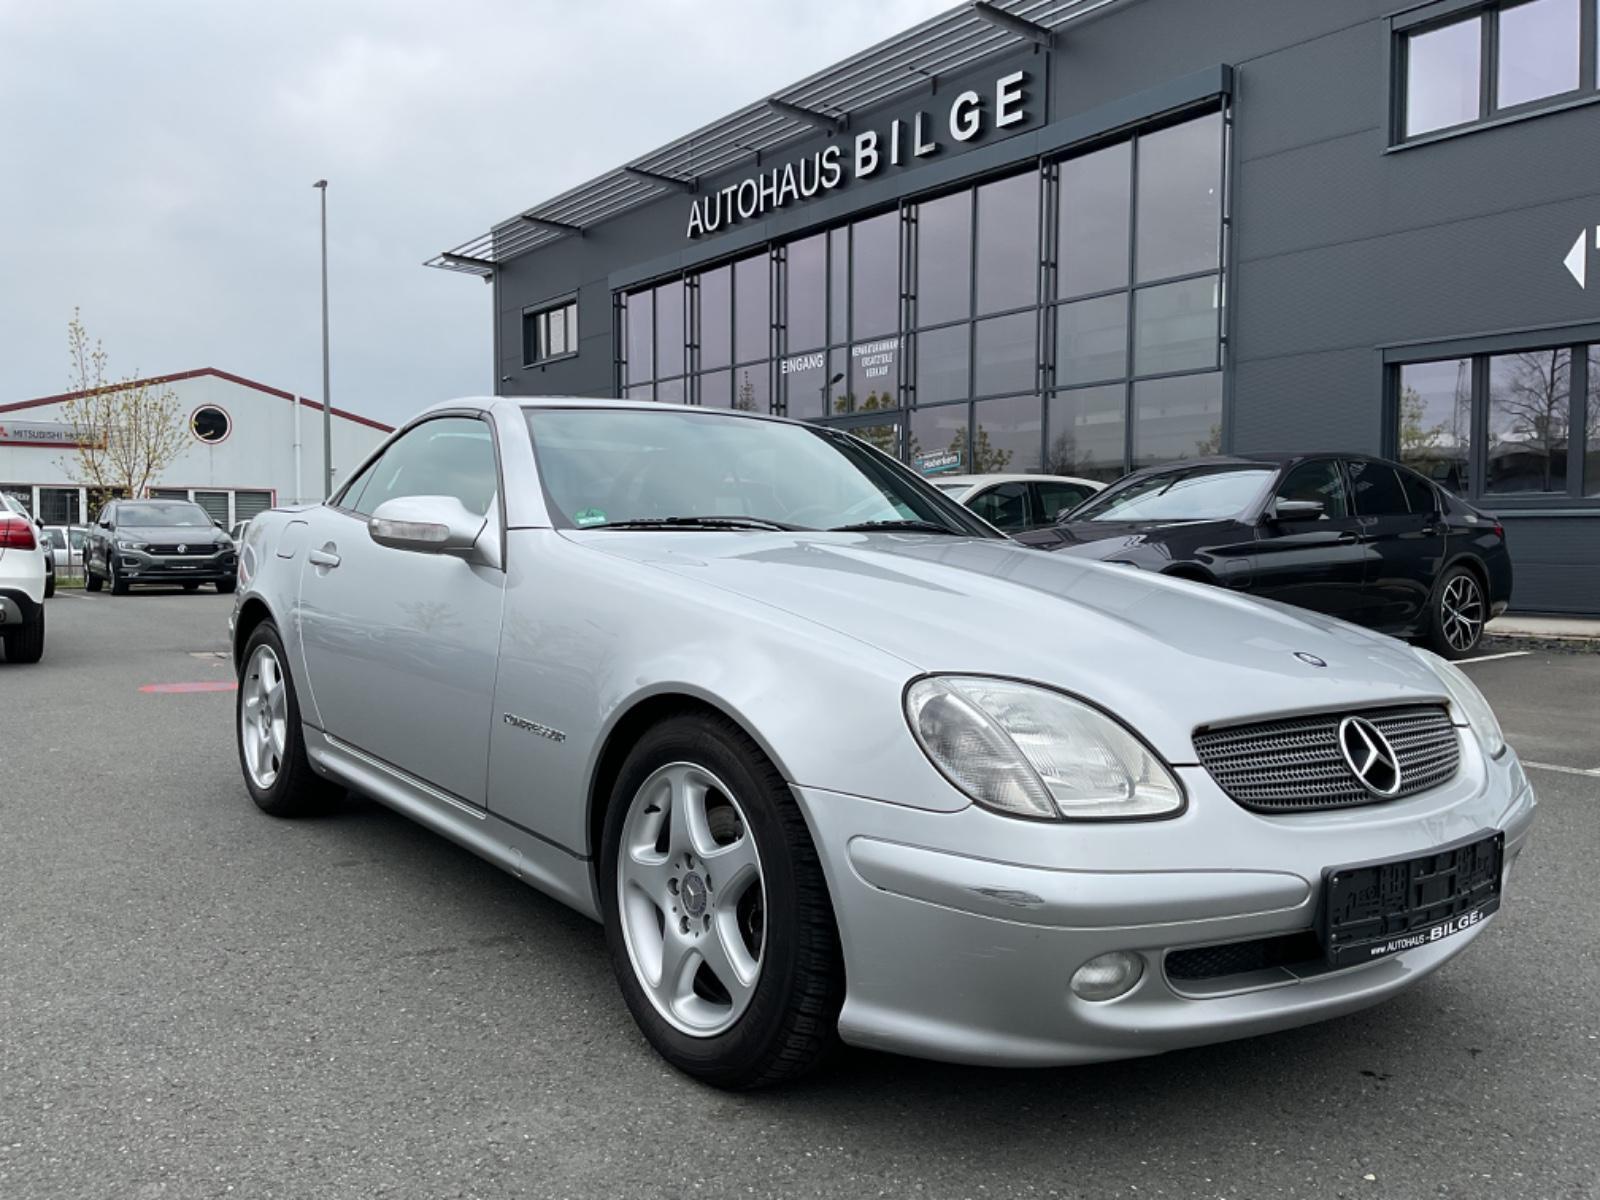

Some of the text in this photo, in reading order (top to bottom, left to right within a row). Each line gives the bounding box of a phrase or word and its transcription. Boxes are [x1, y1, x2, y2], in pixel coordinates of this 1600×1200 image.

[687, 70, 1024, 238] AUTOHAUS BILGE
[782, 354, 824, 374] EINGANG
